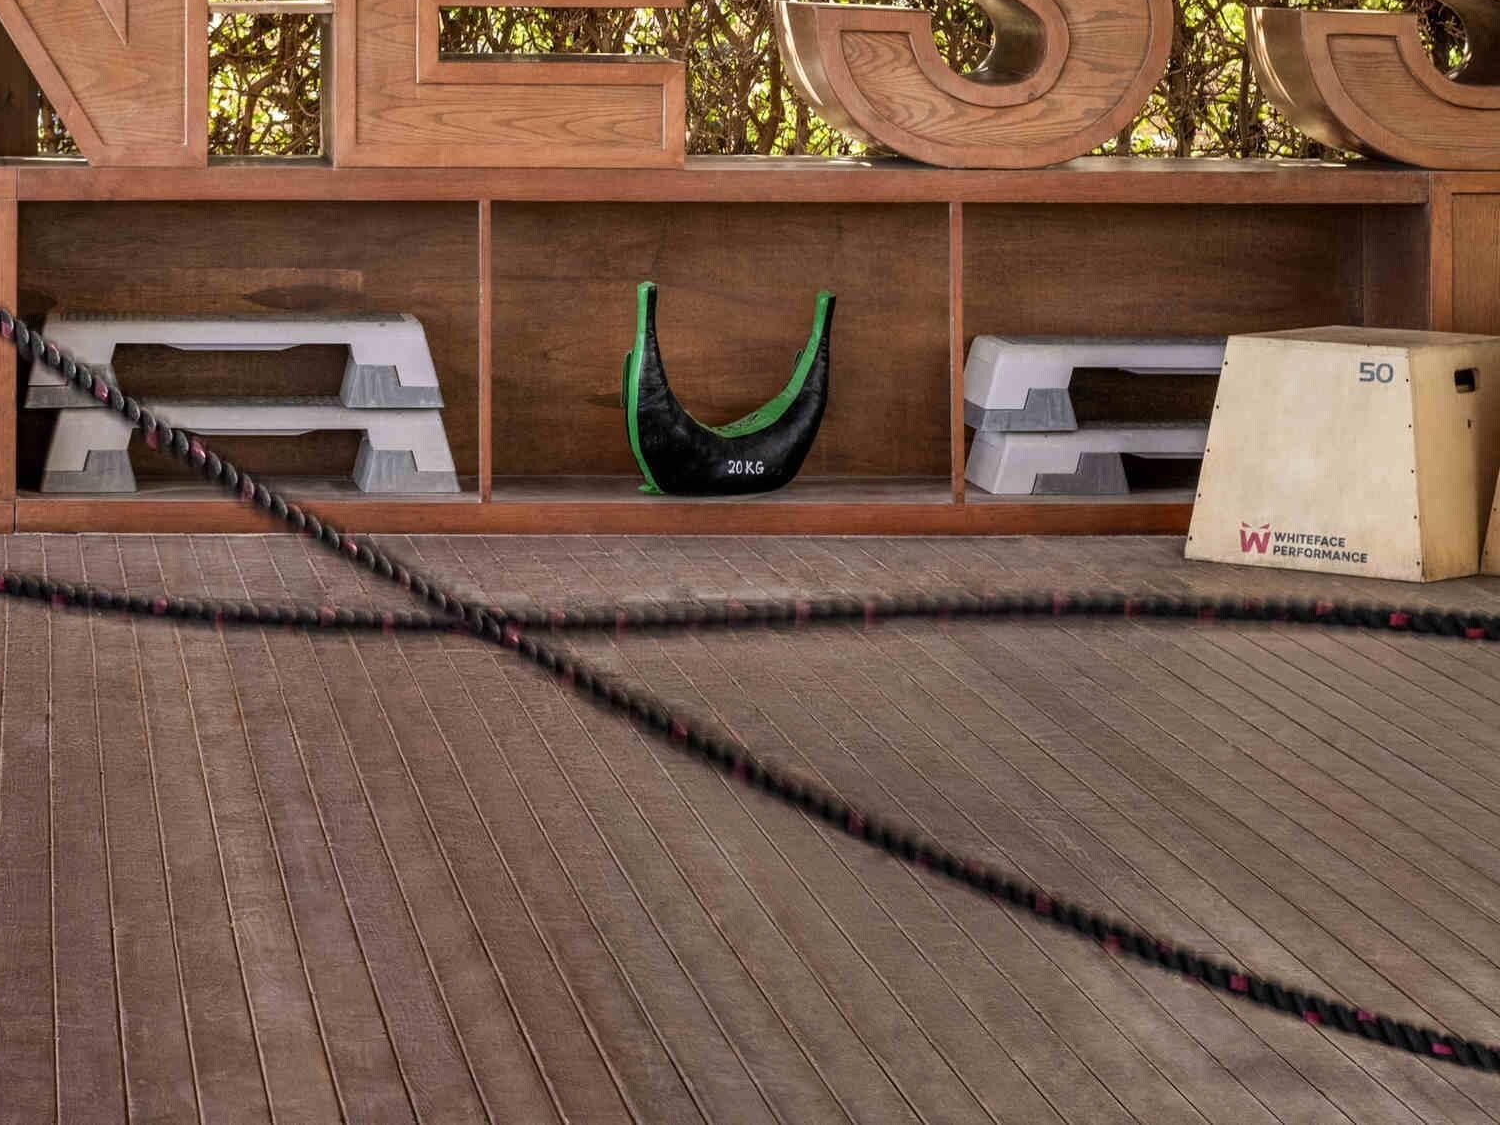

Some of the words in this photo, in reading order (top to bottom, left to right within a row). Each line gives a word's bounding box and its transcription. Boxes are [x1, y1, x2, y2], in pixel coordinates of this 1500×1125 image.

[1359, 362, 1394, 384] 50
[1274, 531, 1345, 548] WHITEFACE
[1273, 545, 1368, 564] PERFORMANCE
